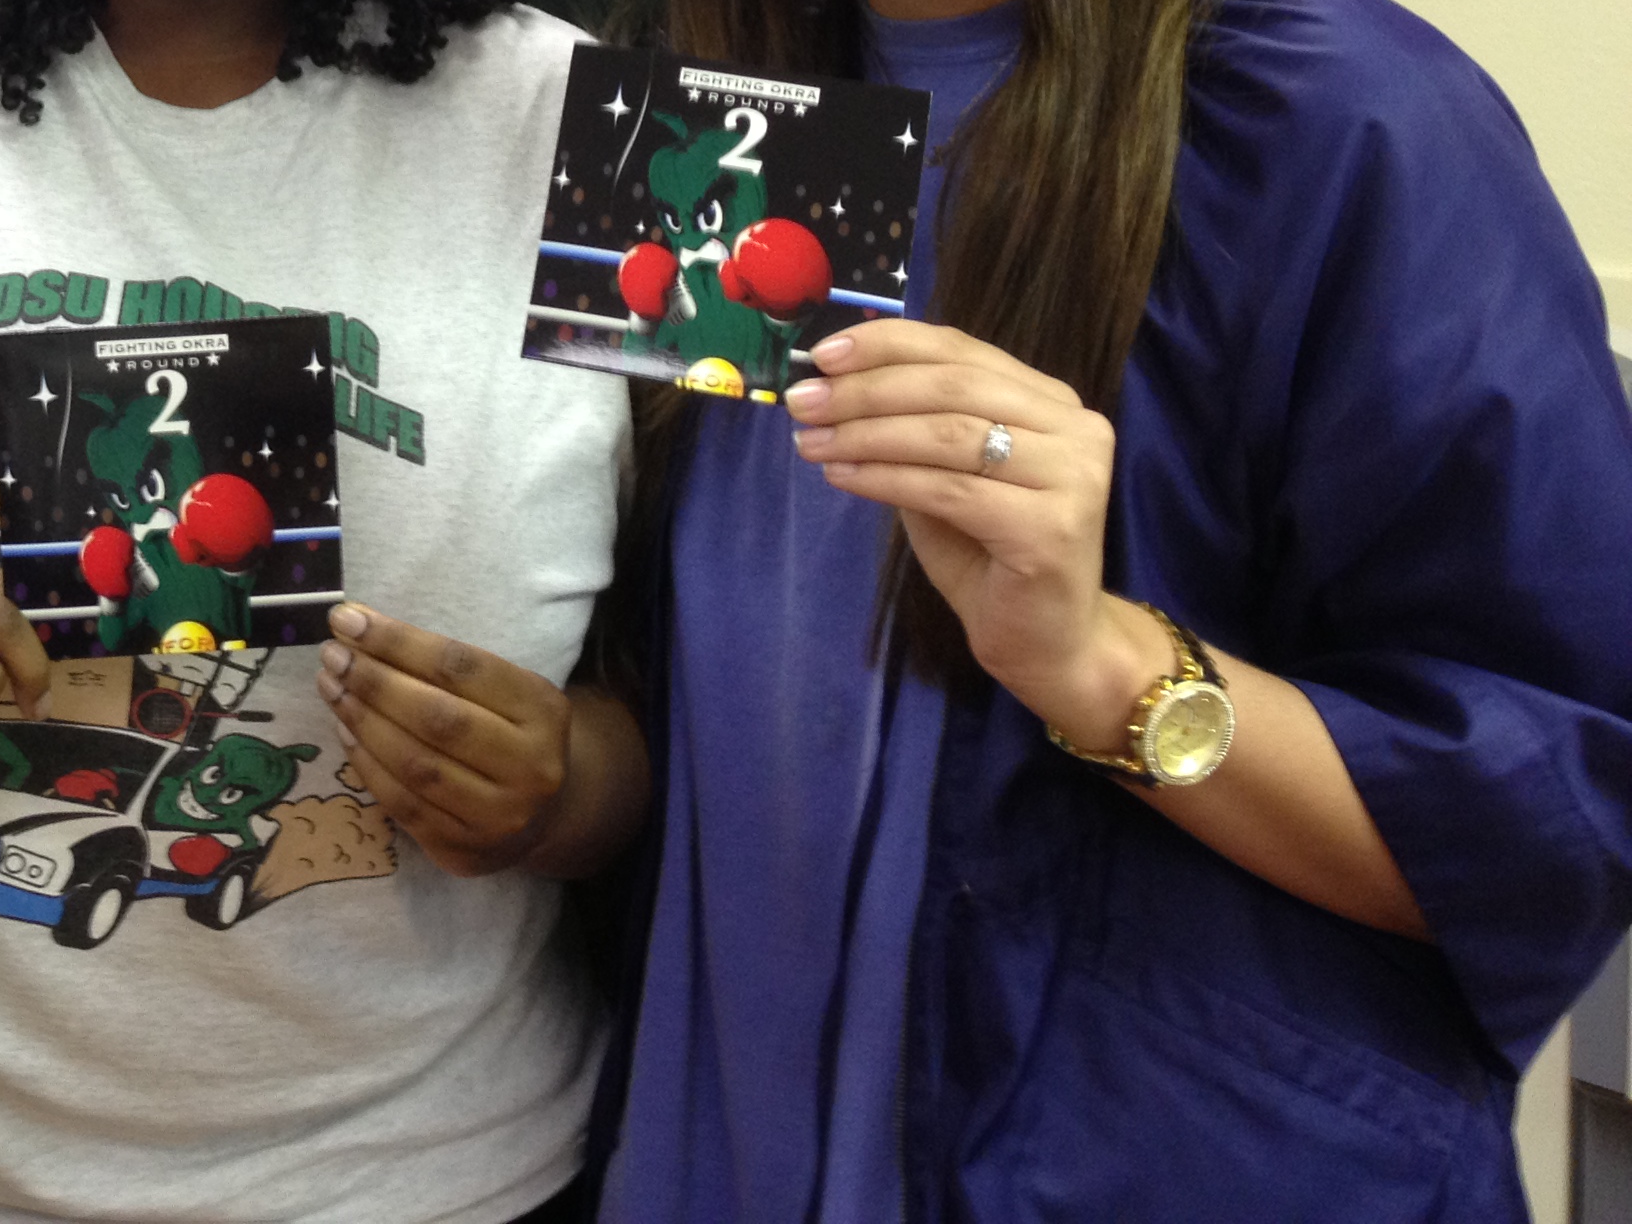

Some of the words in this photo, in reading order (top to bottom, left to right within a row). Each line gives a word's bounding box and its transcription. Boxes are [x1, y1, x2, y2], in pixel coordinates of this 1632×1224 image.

[682, 71, 765, 92] FIGHTING
[770, 84, 817, 100] OKRA
[708, 92, 786, 114] ROUND
[718, 107, 768, 176] 2
[99, 340, 177, 354] FIGHTING
[182, 338, 227, 350] OKRA
[126, 357, 200, 370] ROUND
[145, 369, 190, 436] 2
[335, 372, 426, 467] LIFE
